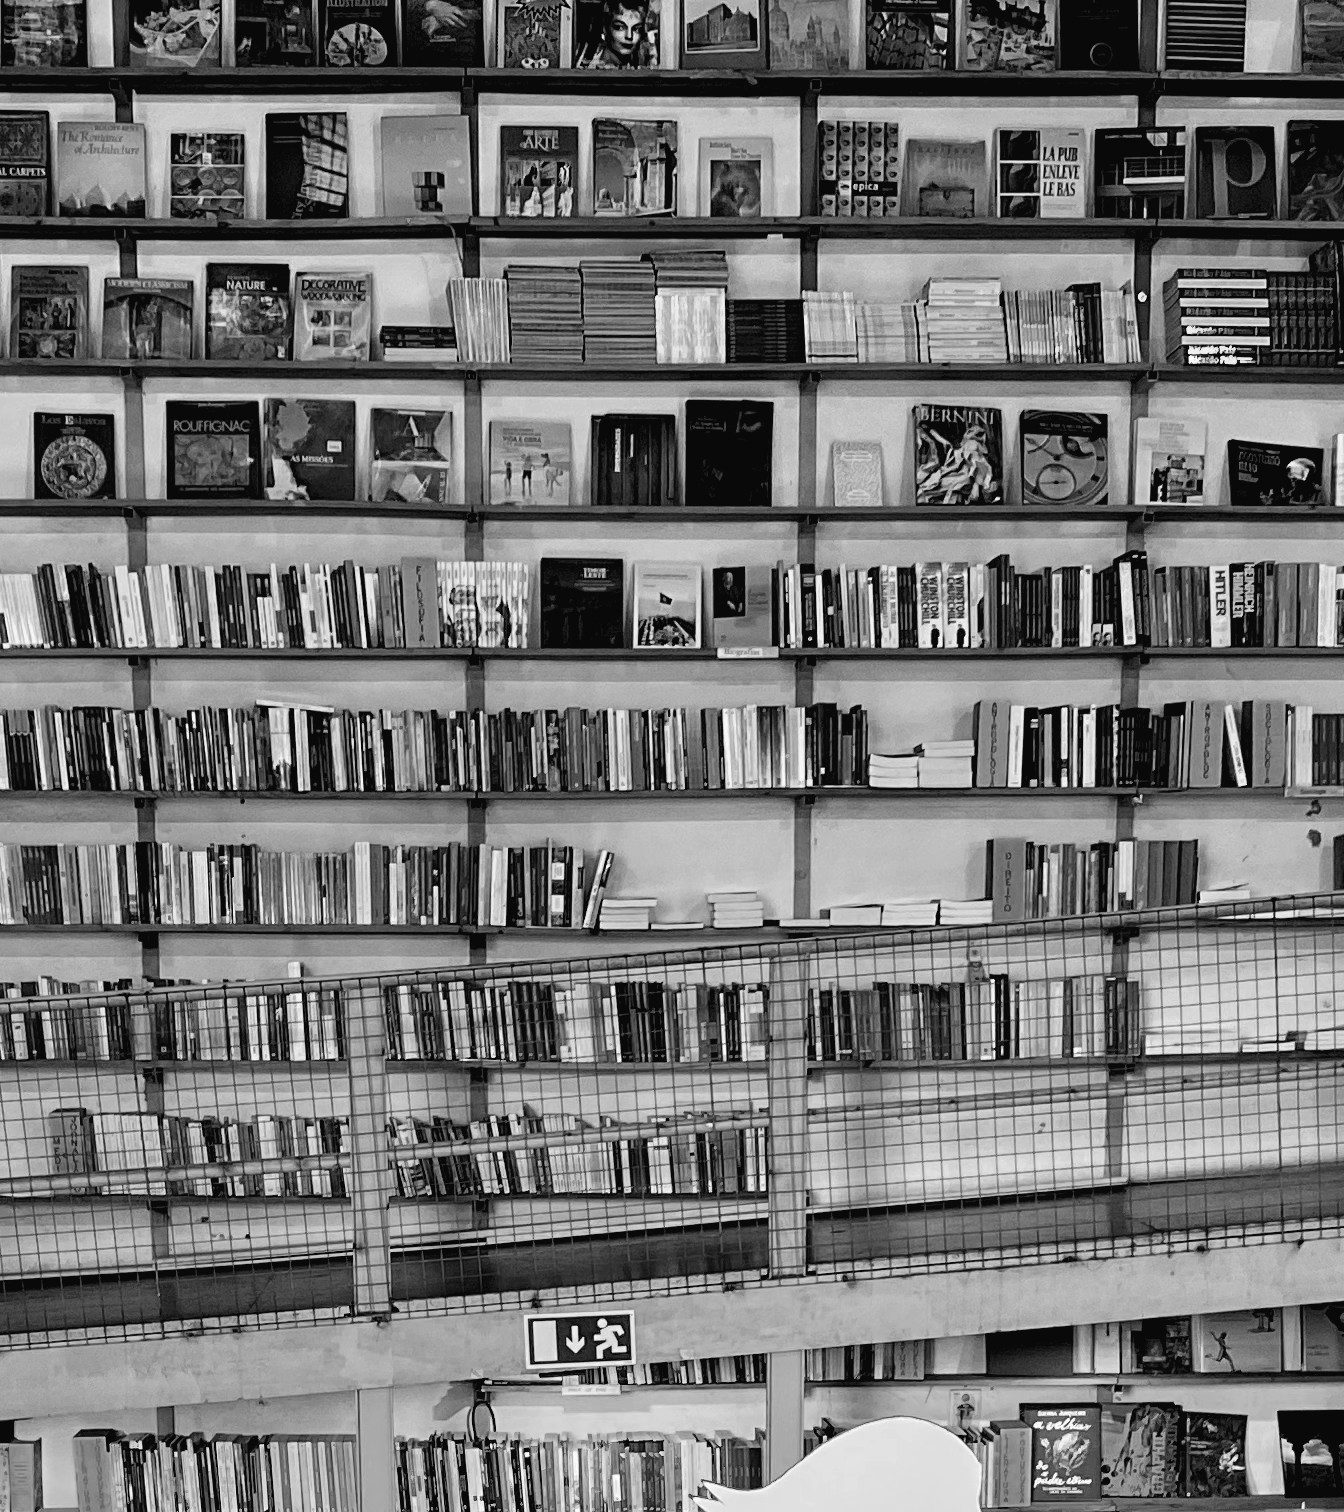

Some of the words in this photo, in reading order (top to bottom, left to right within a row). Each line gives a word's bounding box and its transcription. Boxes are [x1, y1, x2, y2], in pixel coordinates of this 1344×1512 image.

[61, 131, 79, 143] The
[80, 131, 124, 144] Romance
[83, 143, 140, 157] Architecture
[1042, 146, 1056, 162] LA
[1058, 146, 1079, 162] PUB
[9, 166, 46, 177] CARPETS
[1042, 164, 1080, 180] ENLEVE
[852, 181, 879, 194] epica
[1042, 181, 1056, 197] LE
[1058, 181, 1076, 197] BAS
[226, 279, 266, 291] NATURE
[301, 278, 366, 292] DECORATIVE
[920, 405, 995, 427] BERNINI
[173, 419, 250, 432] ROUFFIGNAC
[290, 455, 302, 463] AS
[929, 575, 940, 619] WINSTON
[954, 575, 965, 619] WINSTON
[1215, 570, 1226, 616] HITLER
